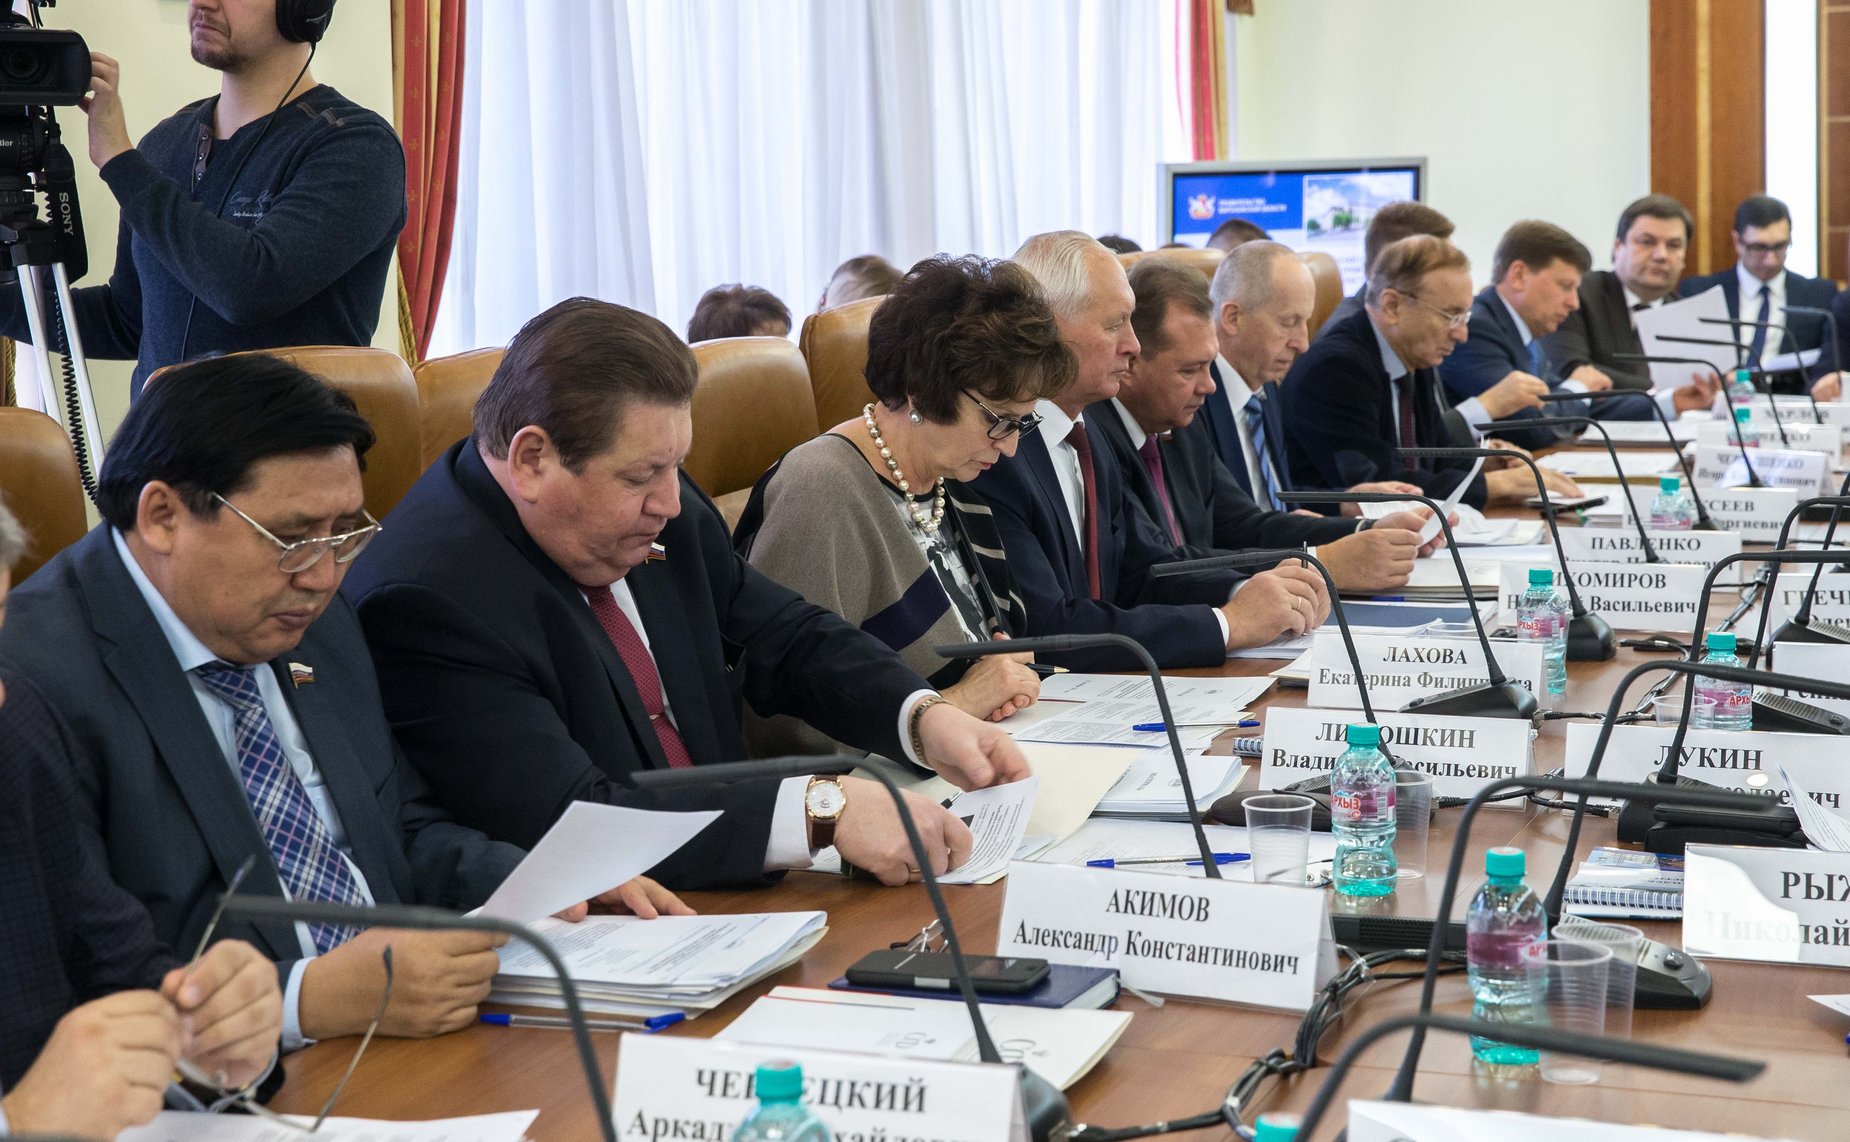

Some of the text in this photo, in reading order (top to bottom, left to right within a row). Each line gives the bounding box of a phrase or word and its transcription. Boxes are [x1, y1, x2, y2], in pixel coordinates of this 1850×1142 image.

[59, 192, 74, 236] SONY
[1550, 571, 1667, 589] ИХОМИРОВ
[1590, 595, 1696, 614] Васильевич
[1519, 620, 1540, 631] РХЫЗ
[1383, 646, 1468, 665] ЛАХОВА
[1654, 745, 1764, 771] ЛУКИН
[1332, 796, 1361, 810] РХЫЗ
[1105, 888, 1211, 923] АКИМОВ
[1012, 919, 1300, 976] Александр Константинович
[696, 1068, 929, 1114] ЧЕЕЦКИЙ
[626, 1109, 735, 1142] Аркад
